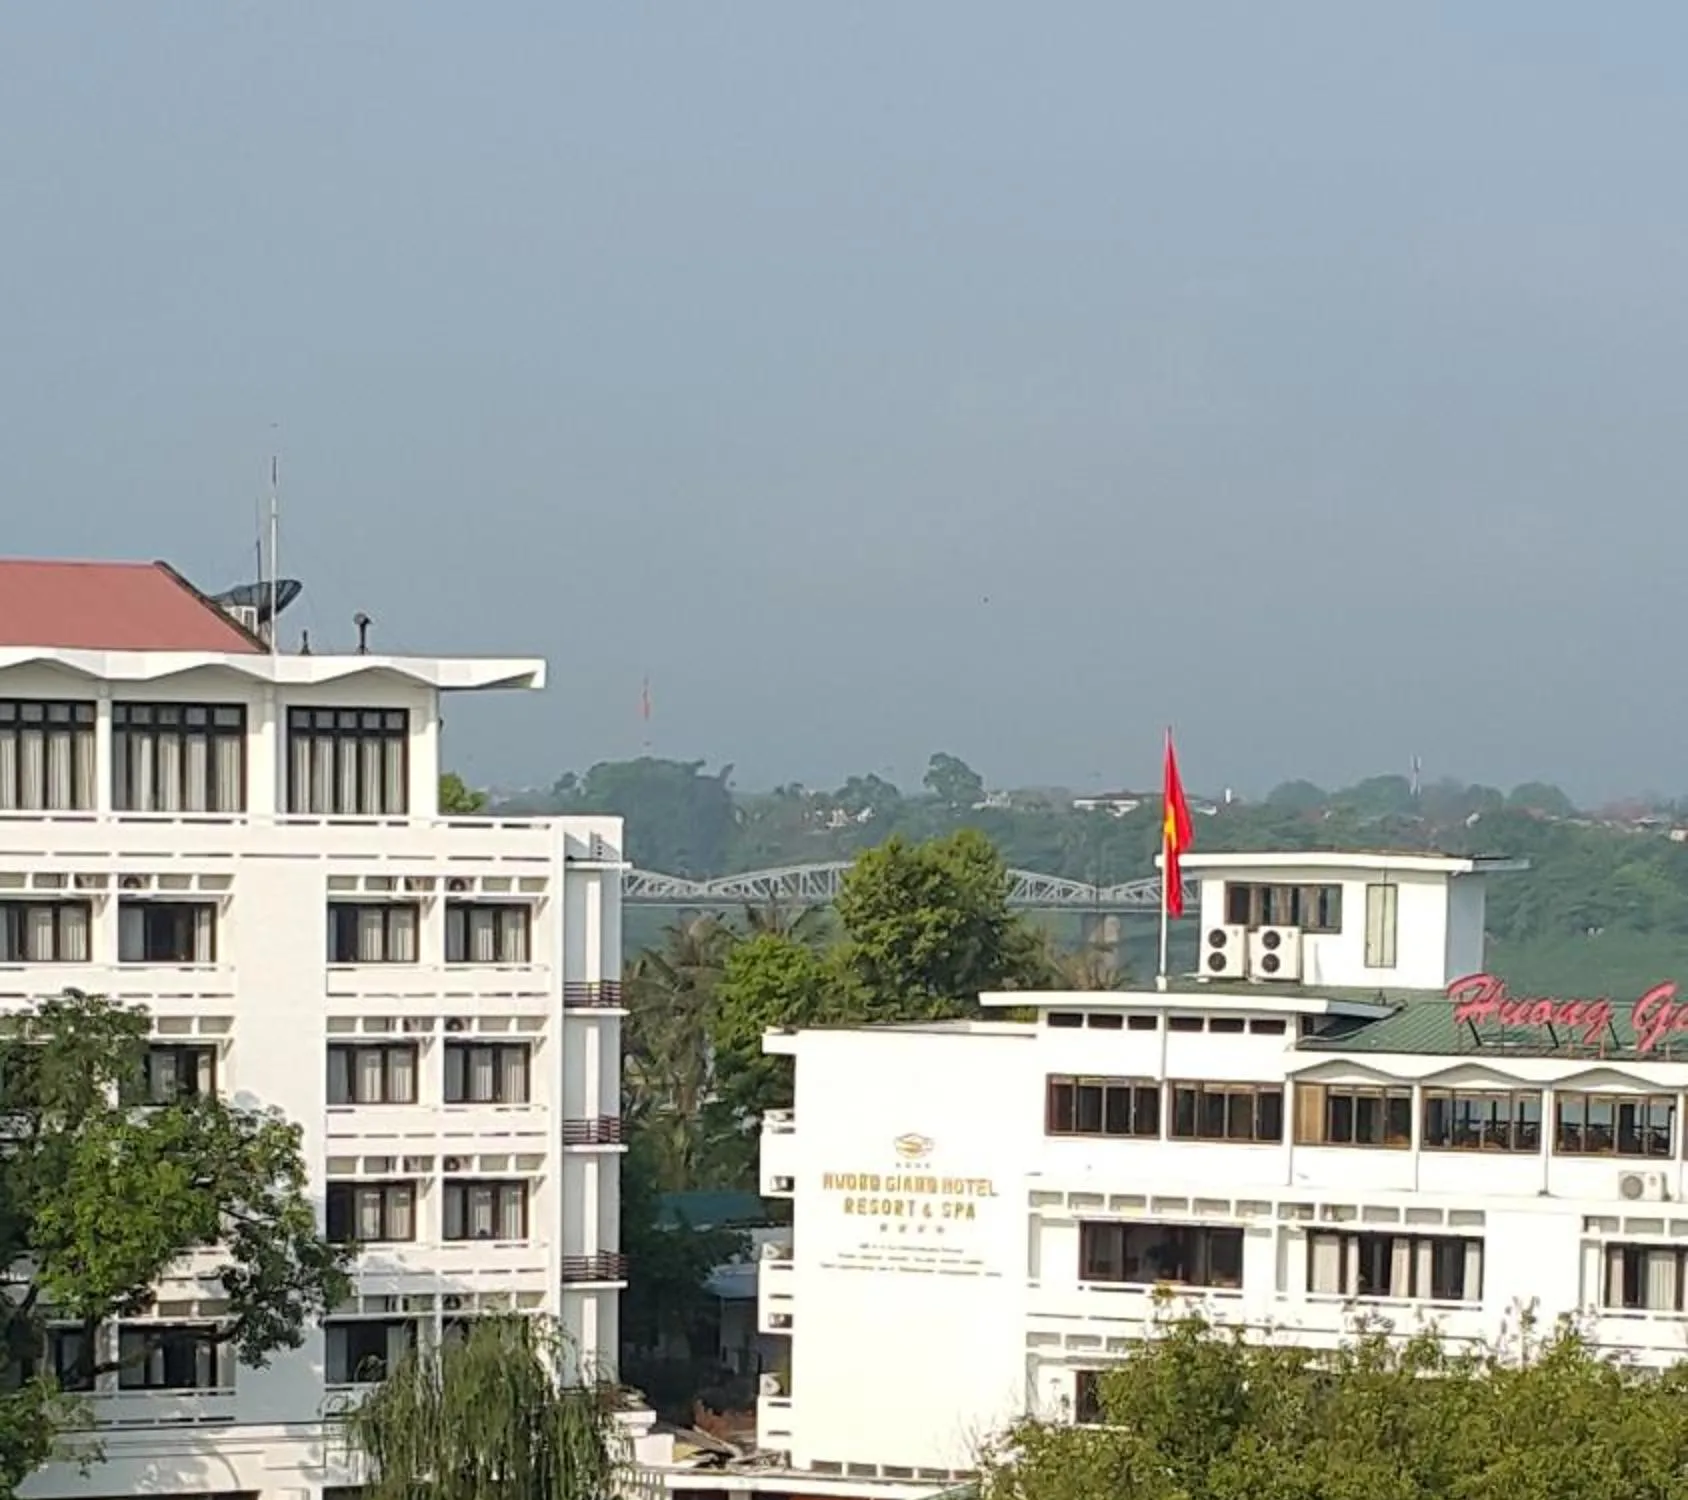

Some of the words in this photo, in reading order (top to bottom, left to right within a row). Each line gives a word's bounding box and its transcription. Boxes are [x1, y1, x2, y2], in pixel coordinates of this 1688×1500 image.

[1445, 973, 1613, 1046] Huong
[886, 1174, 937, 1195] GIANG
[941, 1177, 1000, 1197] HOTEL
[844, 1196, 916, 1217] RESORT
[942, 1201, 977, 1221] SPA
